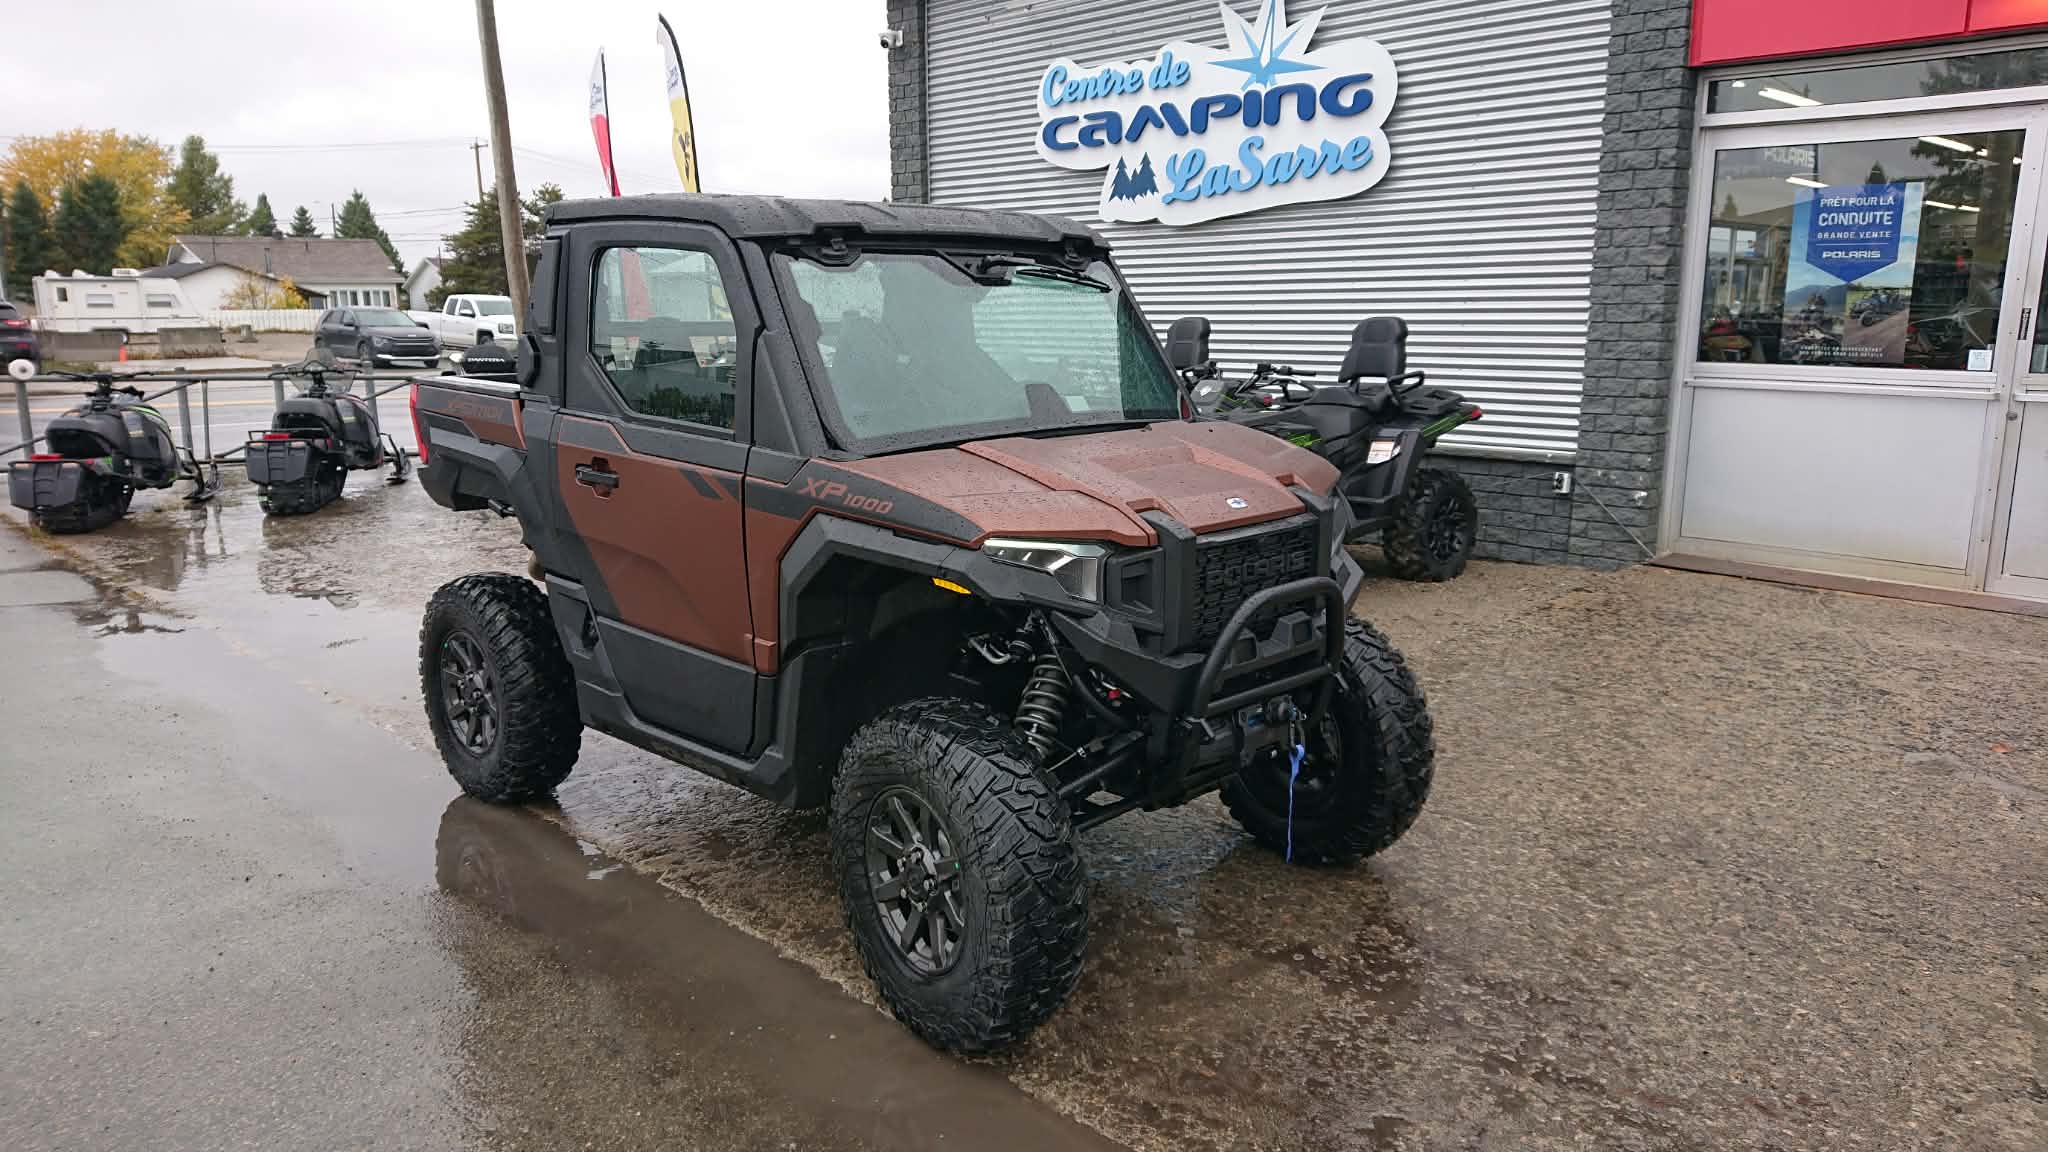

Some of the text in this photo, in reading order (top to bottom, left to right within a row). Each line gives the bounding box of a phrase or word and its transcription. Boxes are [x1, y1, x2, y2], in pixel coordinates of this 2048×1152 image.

[1042, 51, 1191, 107] Centre de
[1161, 135, 1374, 205] LaSarre
[1820, 195, 1895, 208] PRÊT POUR LA
[1818, 211, 1894, 226] CONDUITE
[1817, 230, 1892, 239] GRANDE VENTE
[1821, 250, 1881, 259] POLARIS
[795, 477, 894, 515] XP 1000
